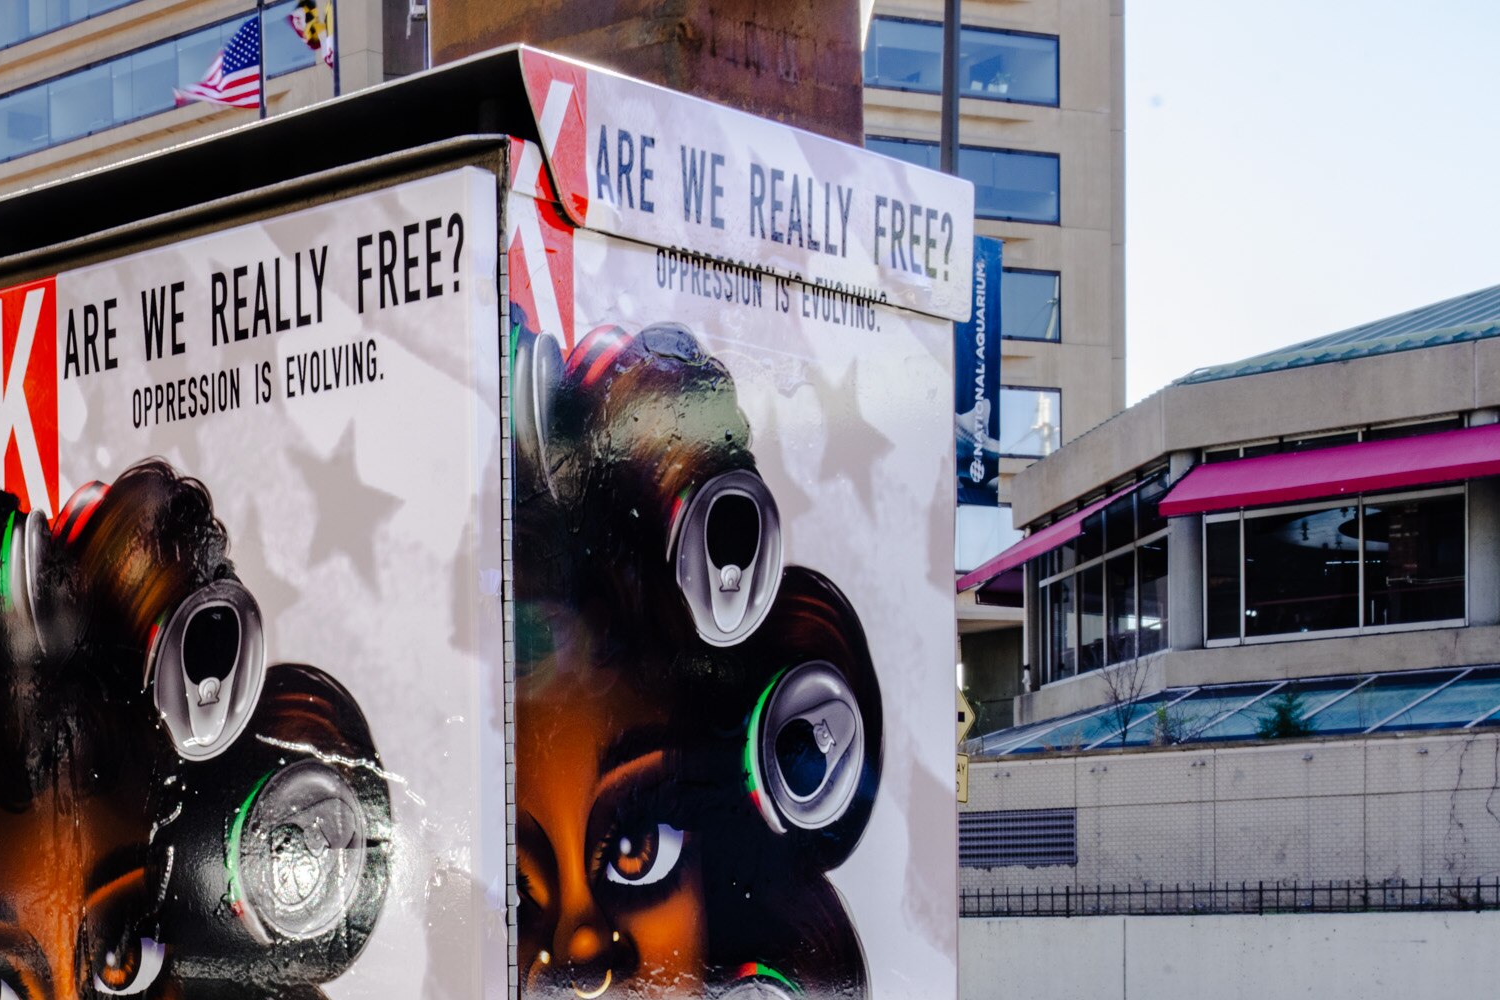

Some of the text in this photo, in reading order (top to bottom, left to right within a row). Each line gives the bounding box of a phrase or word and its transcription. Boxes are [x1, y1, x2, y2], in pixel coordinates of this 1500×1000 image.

[596, 124, 955, 281] ARE WE REALLY FREE?
[63, 211, 466, 380] ARE WE REALLY FREE?
[656, 245, 889, 333] OPPRESSION IS EVOLVING.
[974, 261, 986, 456] NATIONAL AQUARIUM
[132, 339, 385, 430] OPPRESSION IS EVOLVING.
